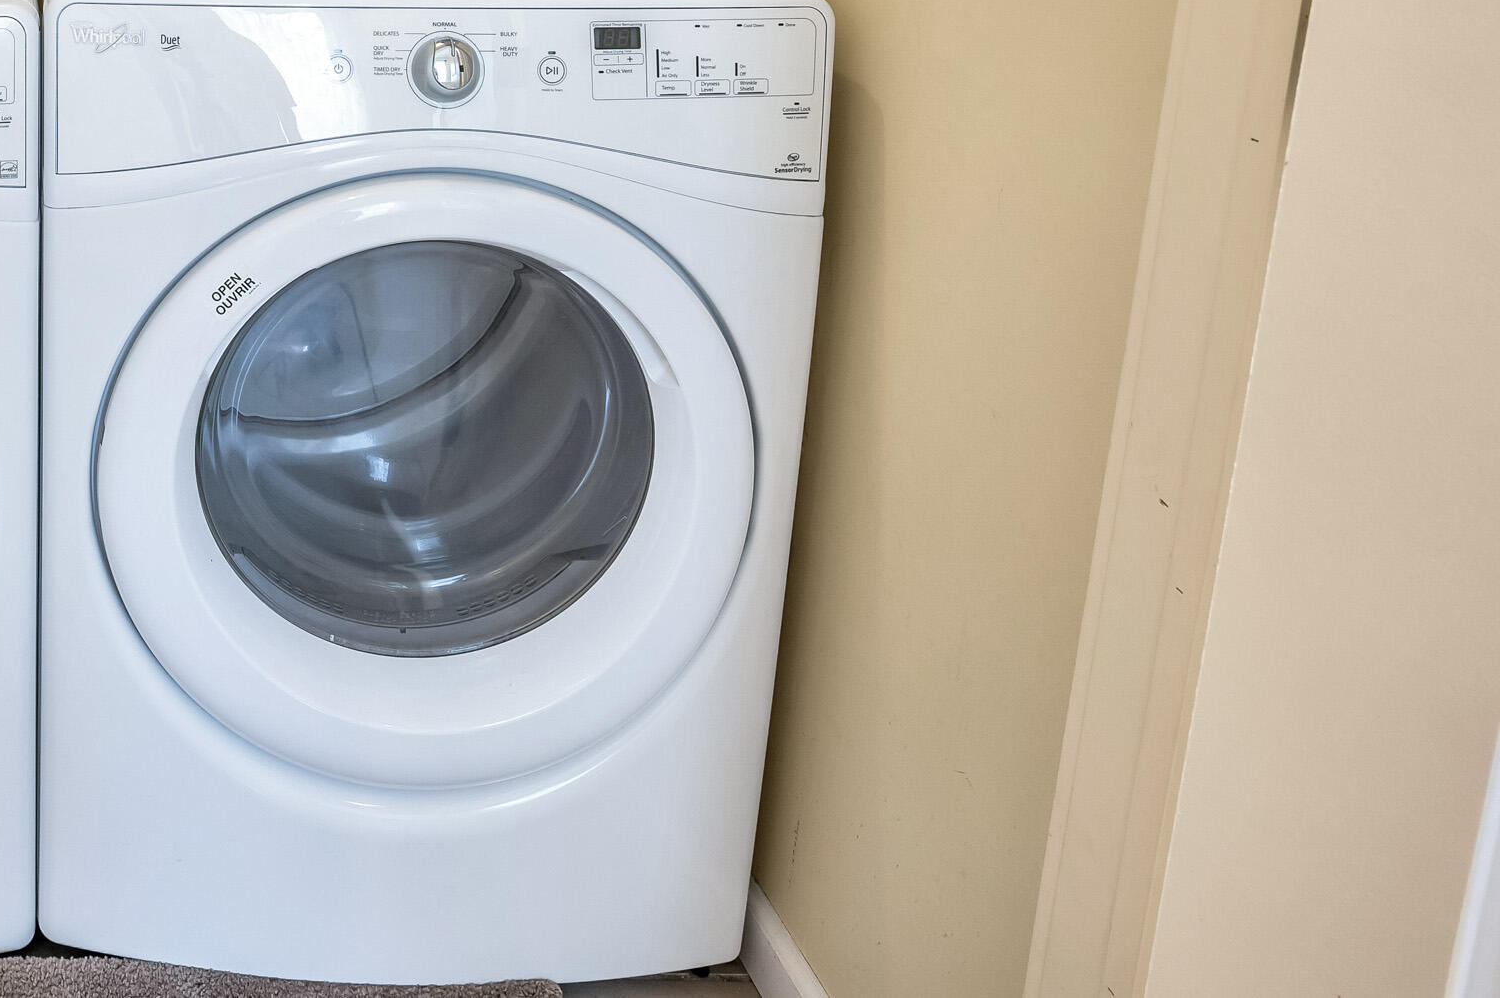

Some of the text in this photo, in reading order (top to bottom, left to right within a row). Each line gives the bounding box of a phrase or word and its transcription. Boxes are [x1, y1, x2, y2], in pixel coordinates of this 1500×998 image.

[160, 34, 180, 45] Duet
[212, 272, 242, 302] OPEN
[216, 277, 256, 315] OUVRIR
